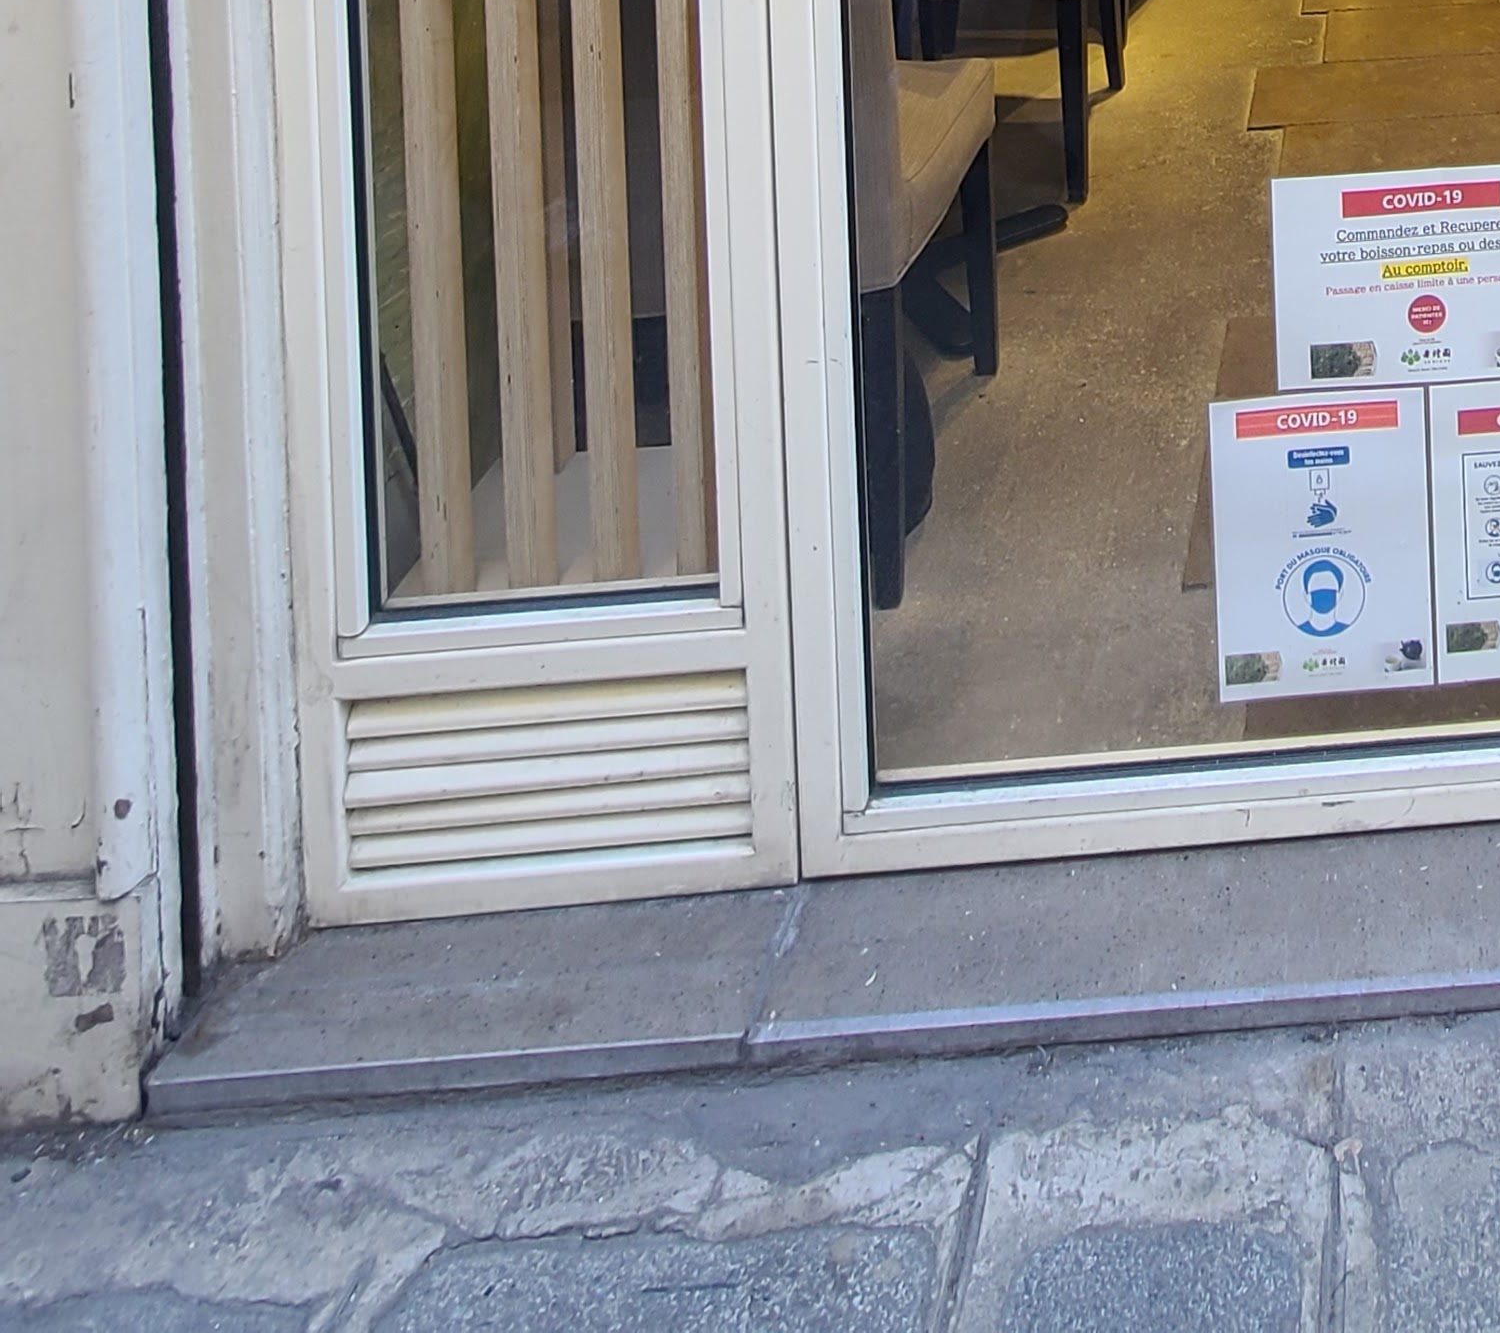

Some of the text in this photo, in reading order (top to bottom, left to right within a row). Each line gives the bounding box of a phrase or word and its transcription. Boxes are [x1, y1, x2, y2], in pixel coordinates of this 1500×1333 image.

[1382, 189, 1463, 210] COVID-19
[1336, 225, 1419, 243] Commandez
[1423, 224, 1435, 235] et
[1320, 249, 1355, 262] votre
[1458, 240, 1475, 250] ou
[1382, 264, 1401, 277] Au
[1325, 284, 1367, 297] Passage
[1369, 284, 1381, 293] en
[1384, 281, 1414, 292] caisse
[1417, 278, 1445, 289] limite
[1447, 276, 1453, 285] à
[1456, 277, 1475, 285] une
[1276, 409, 1357, 429] COVID-19
[1275, 546, 1372, 590] PORT DU MASQUE OBLIGATOIRE
